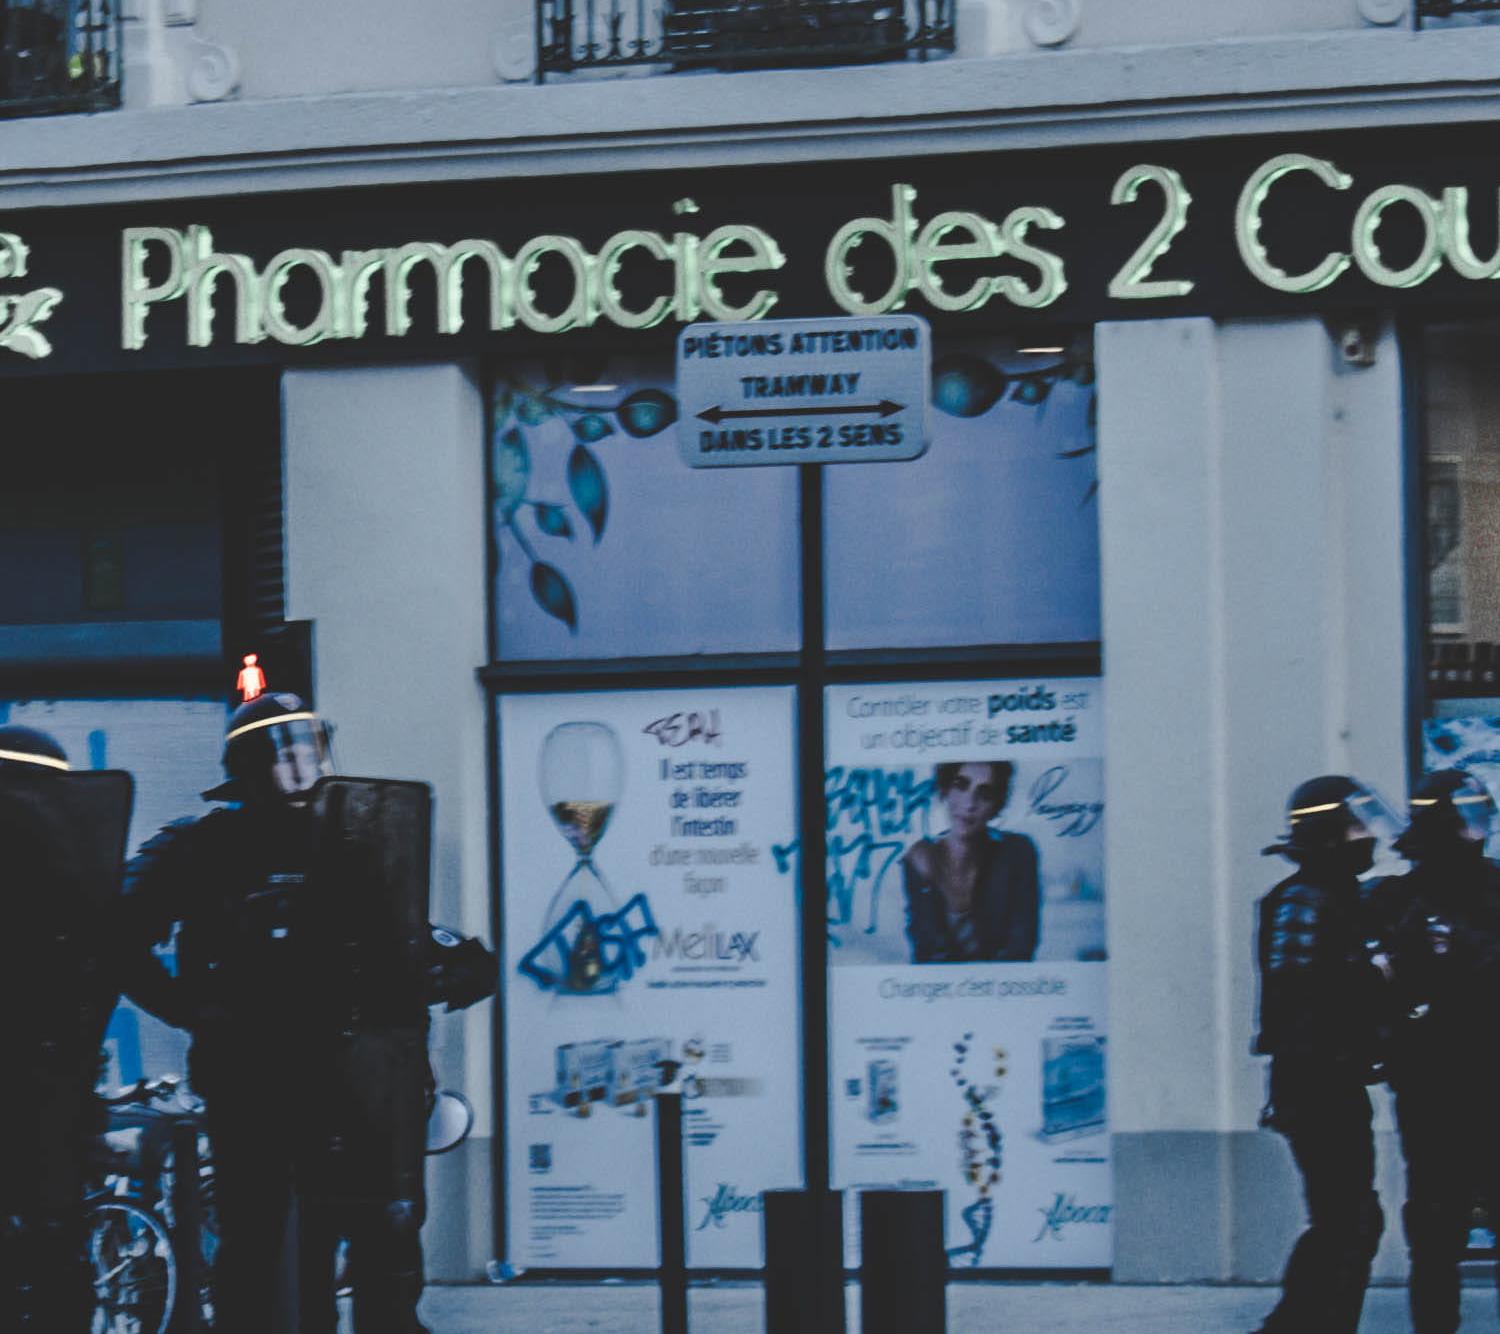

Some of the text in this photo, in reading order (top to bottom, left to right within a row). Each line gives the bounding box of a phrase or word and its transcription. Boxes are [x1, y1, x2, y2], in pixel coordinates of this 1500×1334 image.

[122, 197, 785, 351] Pharmacie
[826, 183, 1067, 316] des
[1109, 164, 1193, 300] 2
[684, 327, 919, 360] PIÉTONS ATTENTION
[740, 371, 862, 399] TRAMWAY
[700, 422, 904, 453] DANS LES 2 SENS
[986, 684, 1057, 719] poids
[1060, 691, 1091, 711] est
[890, 720, 976, 754] objectif
[1005, 714, 1078, 745] santé
[698, 760, 749, 784] temps
